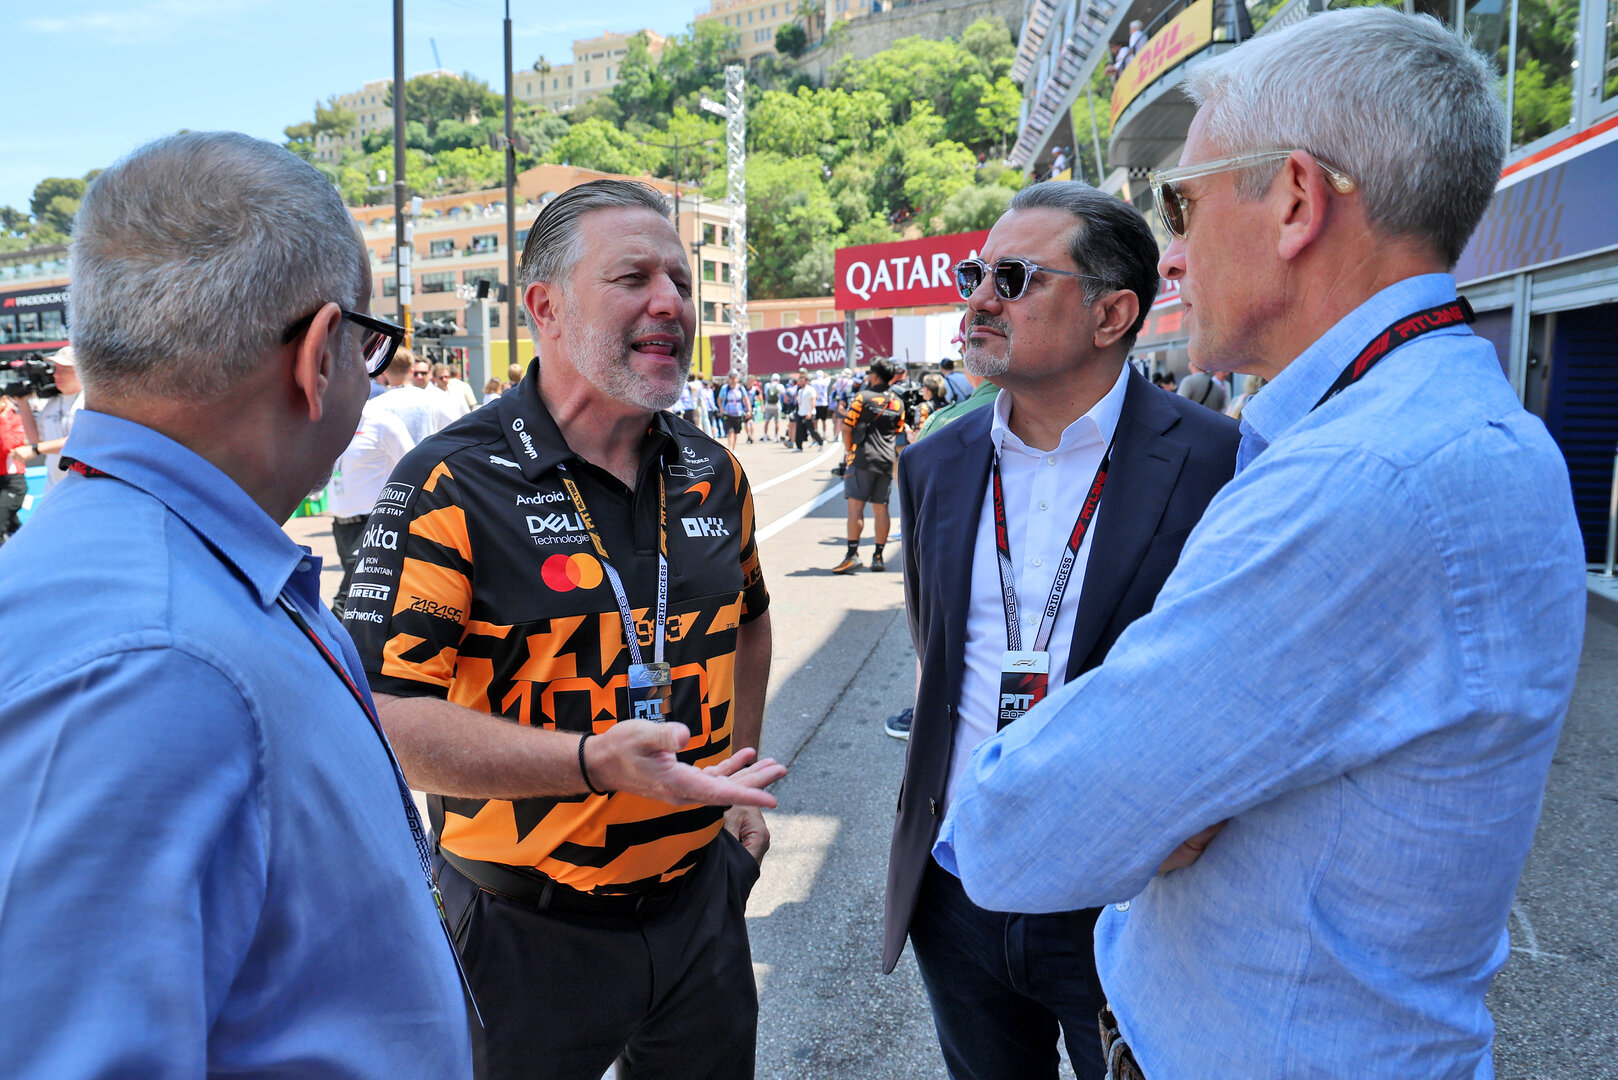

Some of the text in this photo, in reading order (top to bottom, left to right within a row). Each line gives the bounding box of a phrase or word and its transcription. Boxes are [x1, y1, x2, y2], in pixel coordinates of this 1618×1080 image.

[845, 252, 952, 300] QATAR
[1394, 316, 1427, 338] PIT
[798, 345, 864, 365] AIRWAS
[519, 431, 538, 460] allwyn
[516, 491, 565, 506] Android
[387, 507, 405, 517] STAY
[526, 512, 586, 534] DELL
[681, 517, 729, 537] OKX
[362, 523, 398, 550] okta
[531, 534, 590, 545] Technologie
[365, 557, 378, 565] IRON
[364, 566, 393, 576] MOUNTAIN
[659, 564, 667, 599] ACCESS
[1046, 557, 1073, 618] GRID ACCESS
[349, 583, 391, 600] PIRELLI
[343, 607, 384, 624] freshworks
[658, 601, 666, 626] GRID
[634, 698, 664, 715] PIT
[1001, 693, 1035, 709] PIT
[1000, 709, 1026, 719] 202
